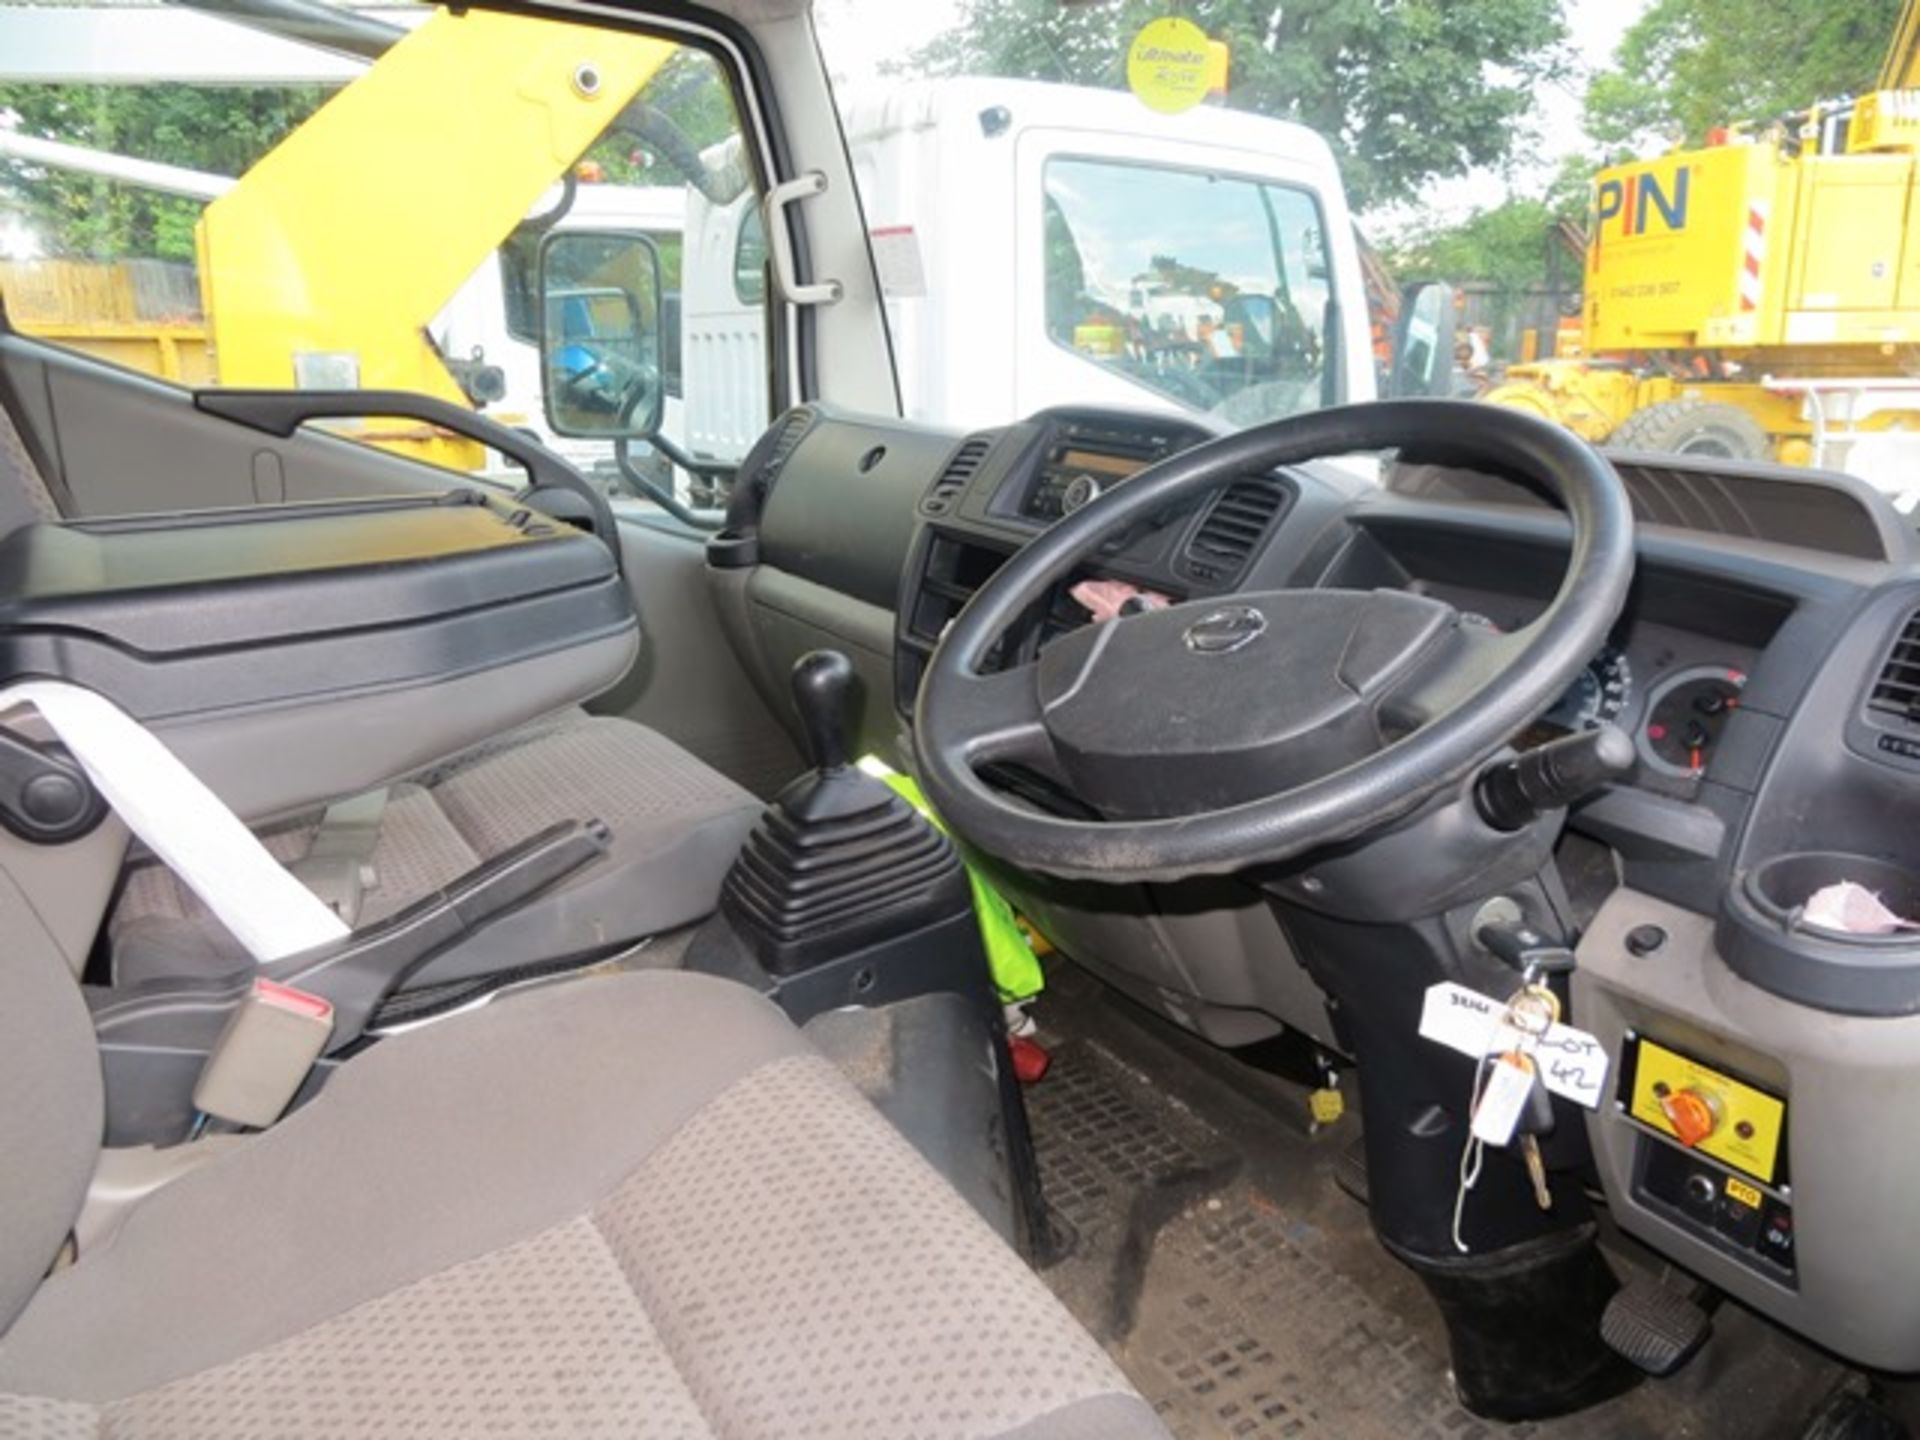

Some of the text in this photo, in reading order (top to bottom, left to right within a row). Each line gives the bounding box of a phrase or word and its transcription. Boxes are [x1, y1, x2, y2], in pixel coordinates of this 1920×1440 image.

[1599, 167, 1690, 236] PIN
[1537, 1020, 1597, 1056] LOT
[1550, 1059, 1596, 1090] 42
[1730, 1182, 1757, 1203] PTO
